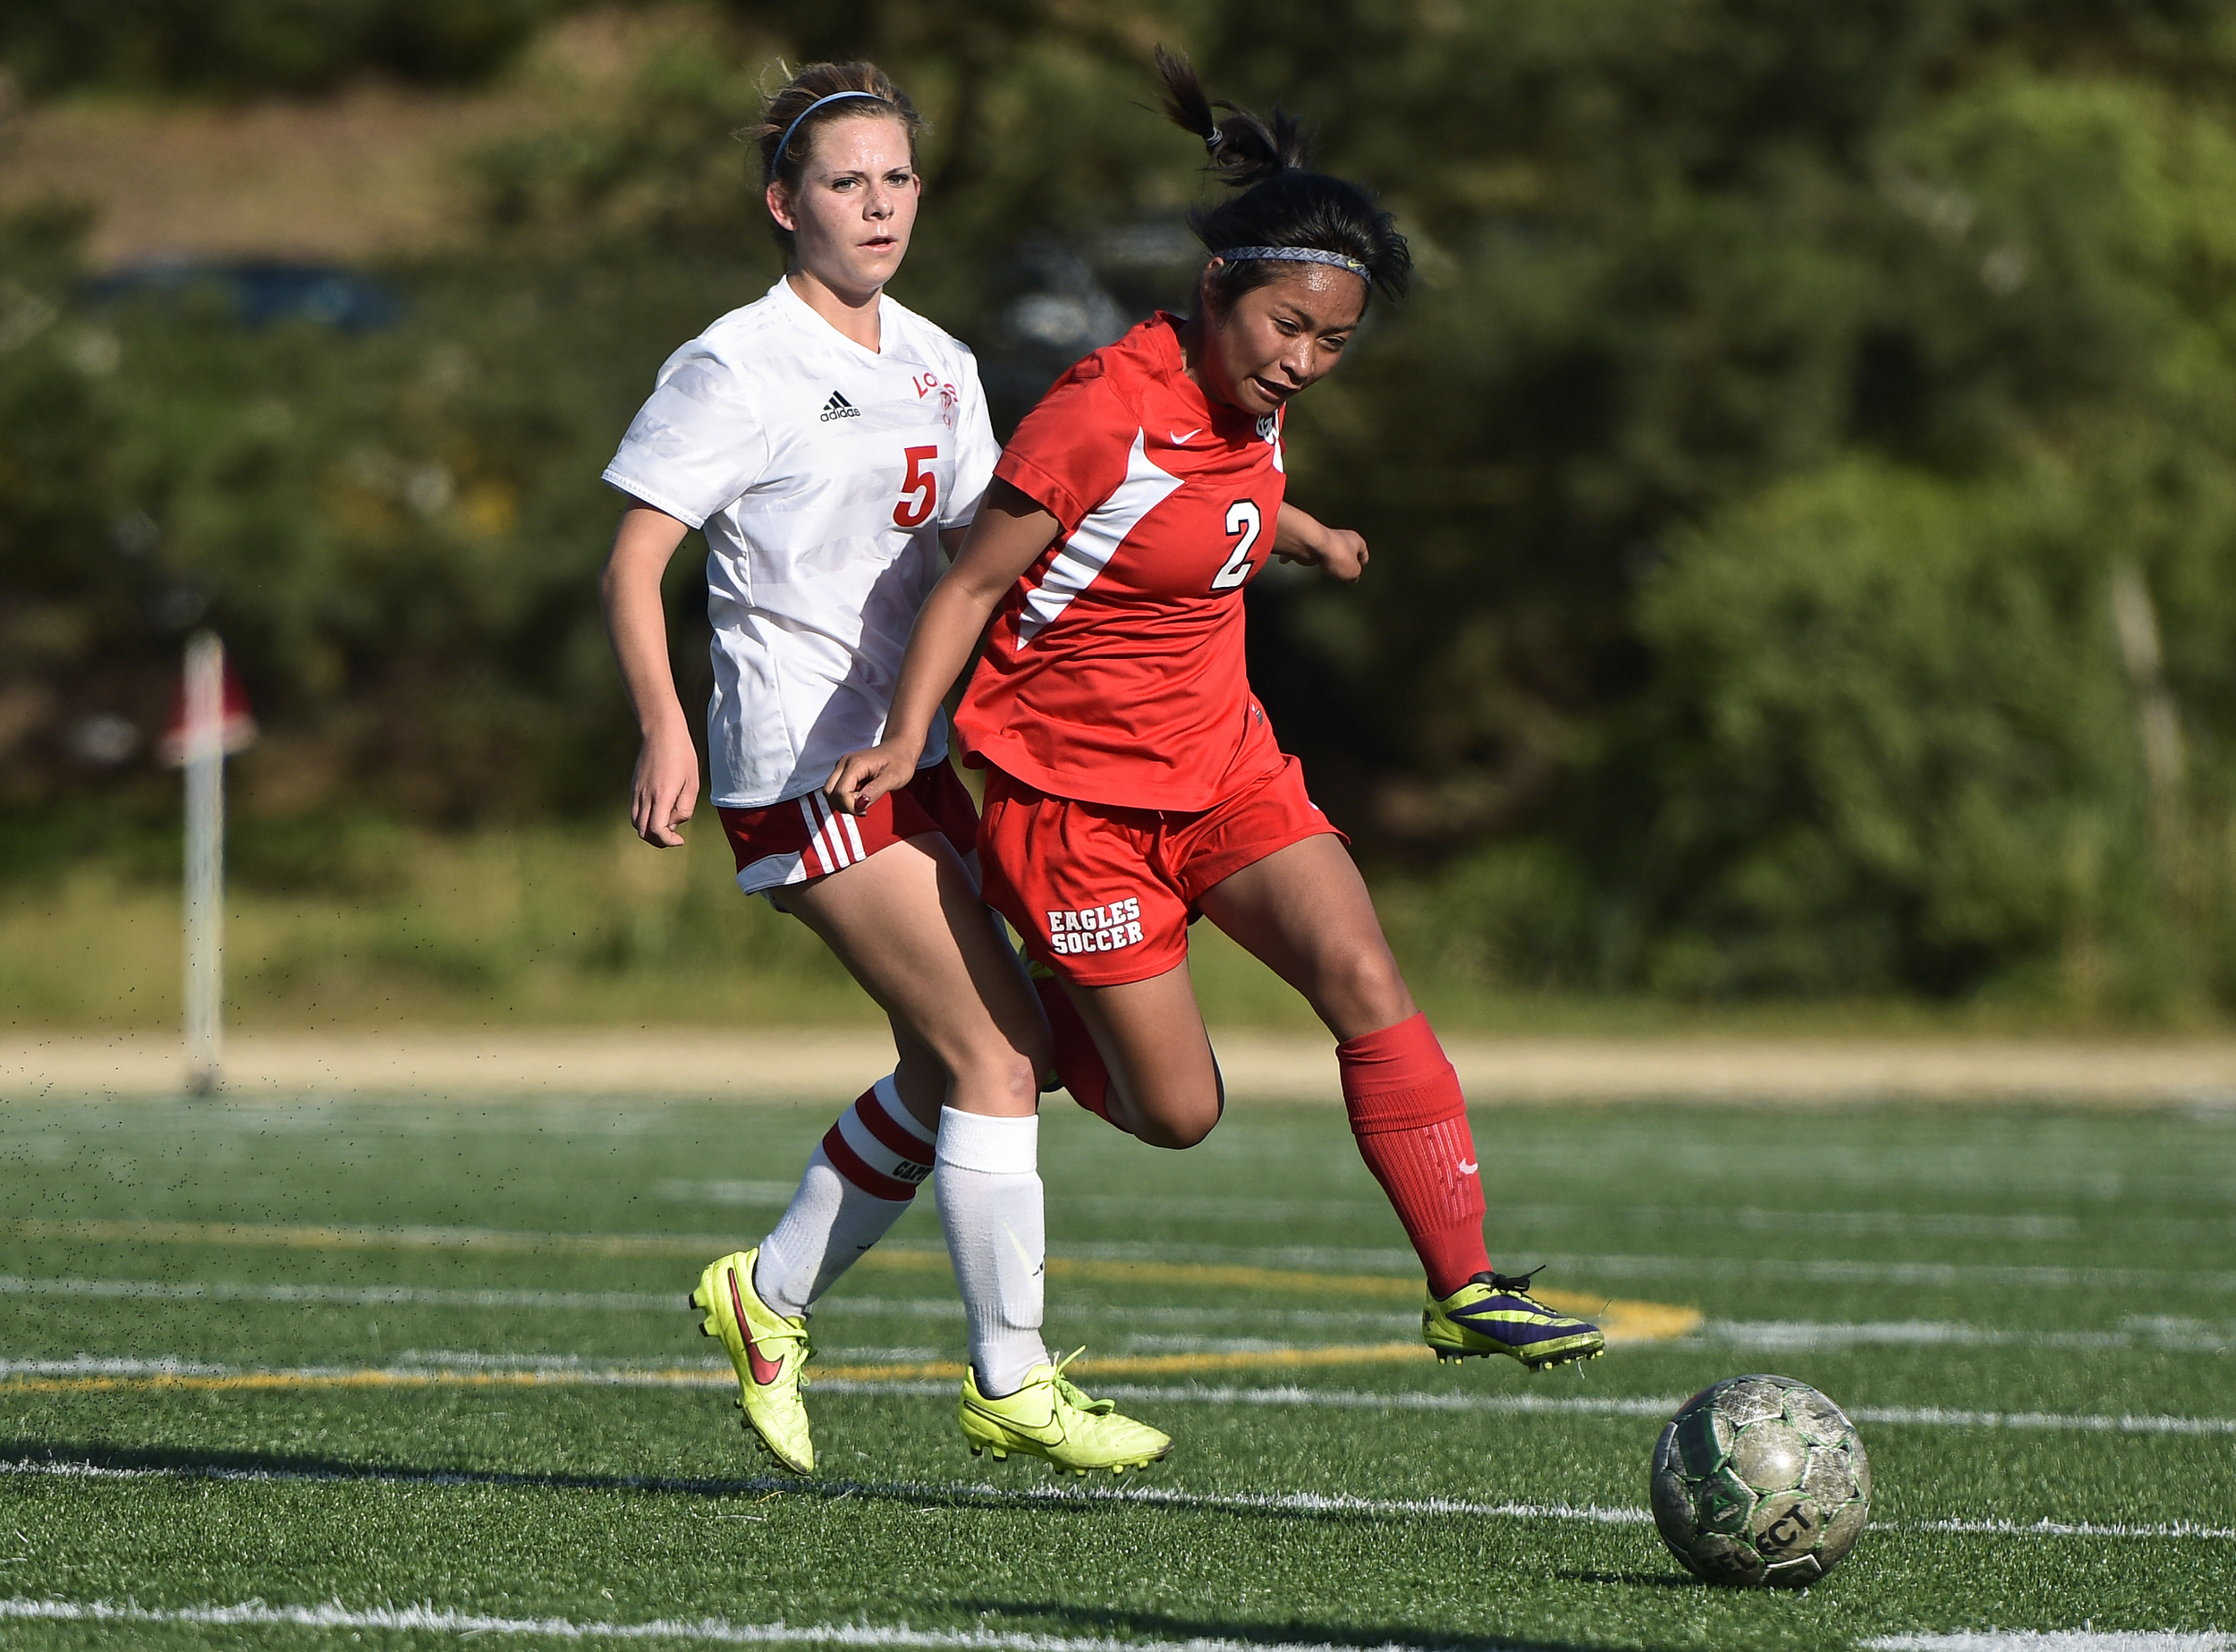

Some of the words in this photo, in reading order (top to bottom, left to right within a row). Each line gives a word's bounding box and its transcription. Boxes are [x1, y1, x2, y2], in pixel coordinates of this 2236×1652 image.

[820, 406, 860, 422] adidas
[893, 445, 937, 527] 5
[1210, 498, 1262, 591] 2
[1046, 896, 1140, 932] EAGLES
[1051, 920, 1144, 954] SOCCER
